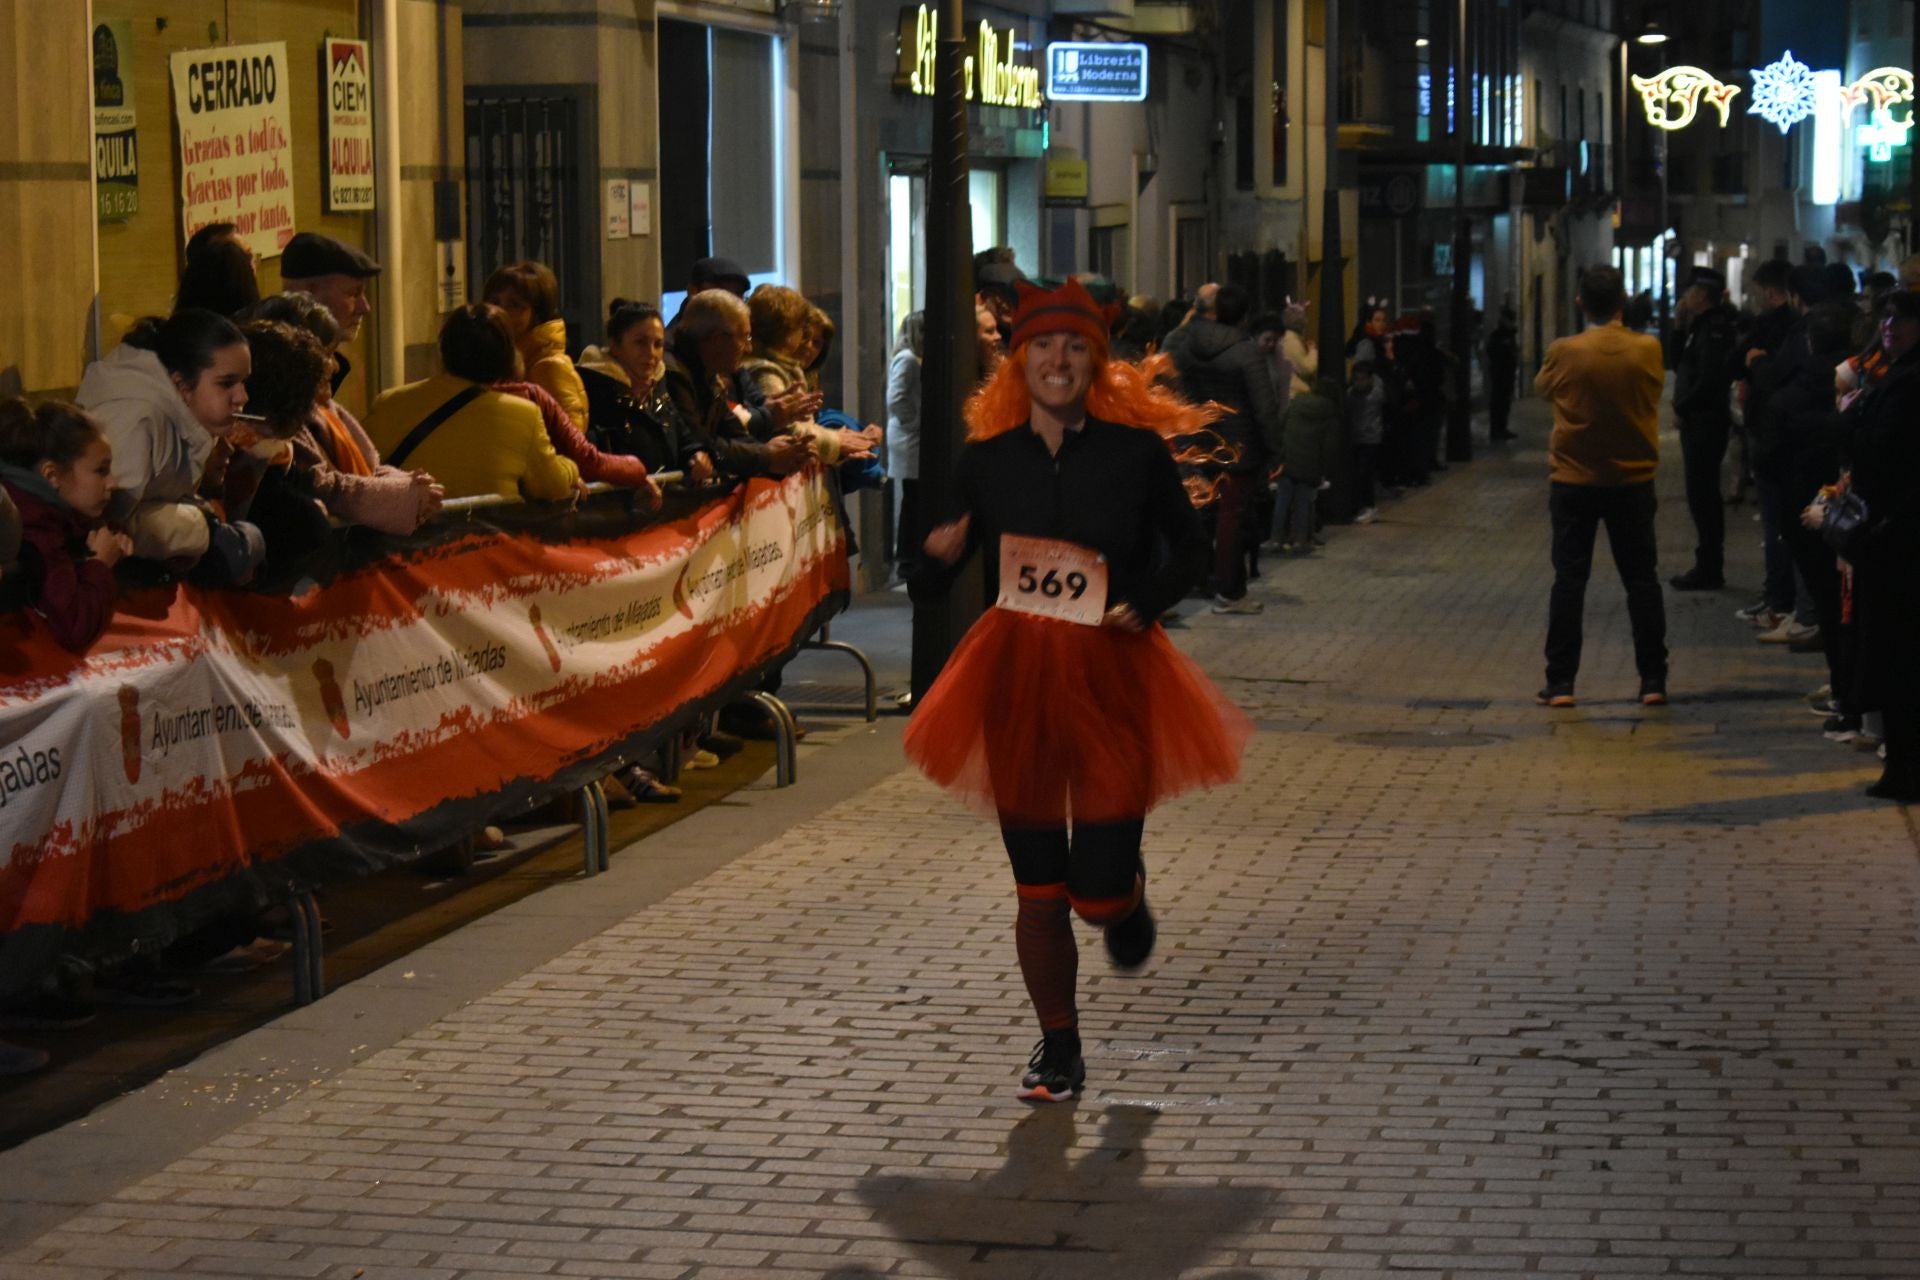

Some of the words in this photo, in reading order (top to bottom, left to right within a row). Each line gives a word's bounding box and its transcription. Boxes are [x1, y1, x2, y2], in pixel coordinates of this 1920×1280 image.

[188, 54, 276, 114] CERRADO
[1081, 68, 1137, 81] Moderna
[333, 81, 367, 112] CIEM
[236, 134, 245, 156] a
[332, 137, 371, 175] ALQUILA
[236, 173, 257, 208] por
[261, 155, 288, 192] todo.
[236, 212, 256, 235] por
[260, 201, 291, 231] tanto.
[1018, 564, 1088, 600] 569
[353, 662, 436, 716] Ayuntamiento
[437, 654, 452, 685] de
